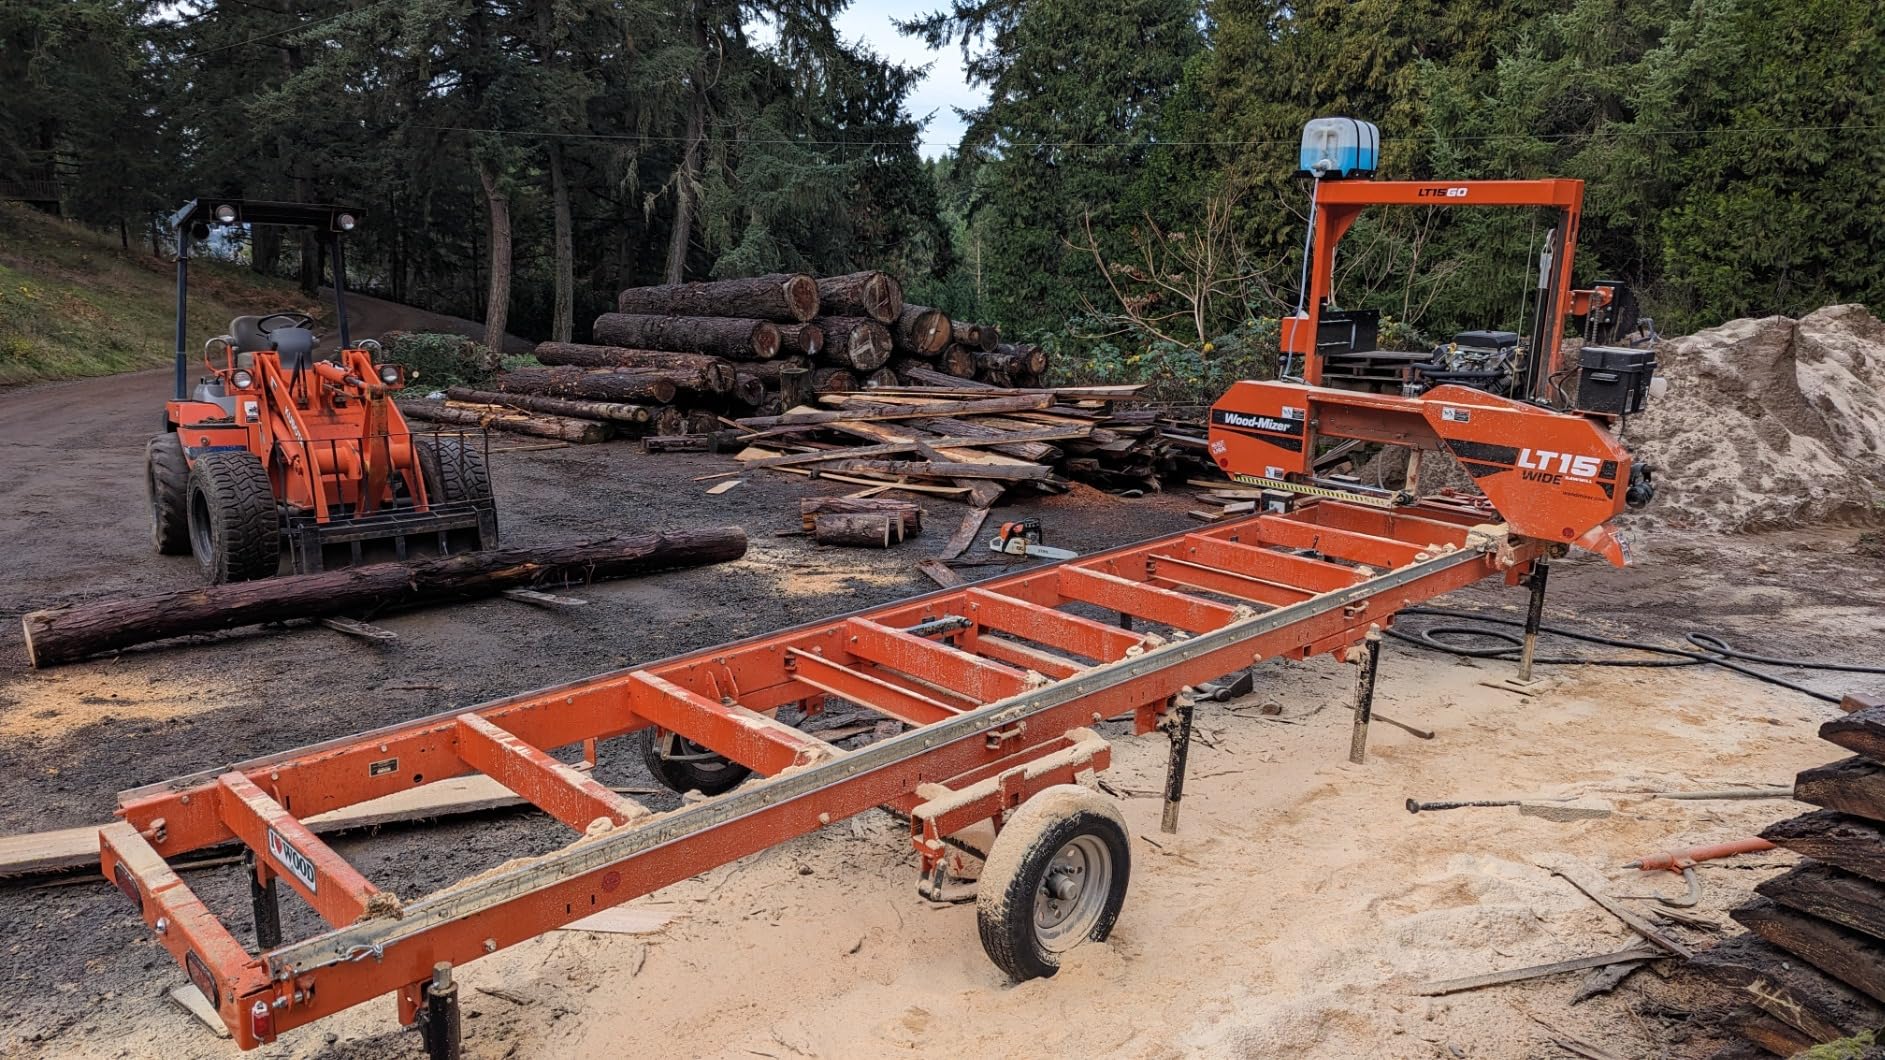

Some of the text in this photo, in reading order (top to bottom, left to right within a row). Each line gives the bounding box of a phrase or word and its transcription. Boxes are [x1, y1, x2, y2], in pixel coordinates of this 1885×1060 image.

[1224, 412, 1290, 431] Wood-Mizer
[1517, 447, 1602, 478] LT15
[1522, 470, 1563, 485] WIDE
[270, 831, 314, 883] I WOOD
